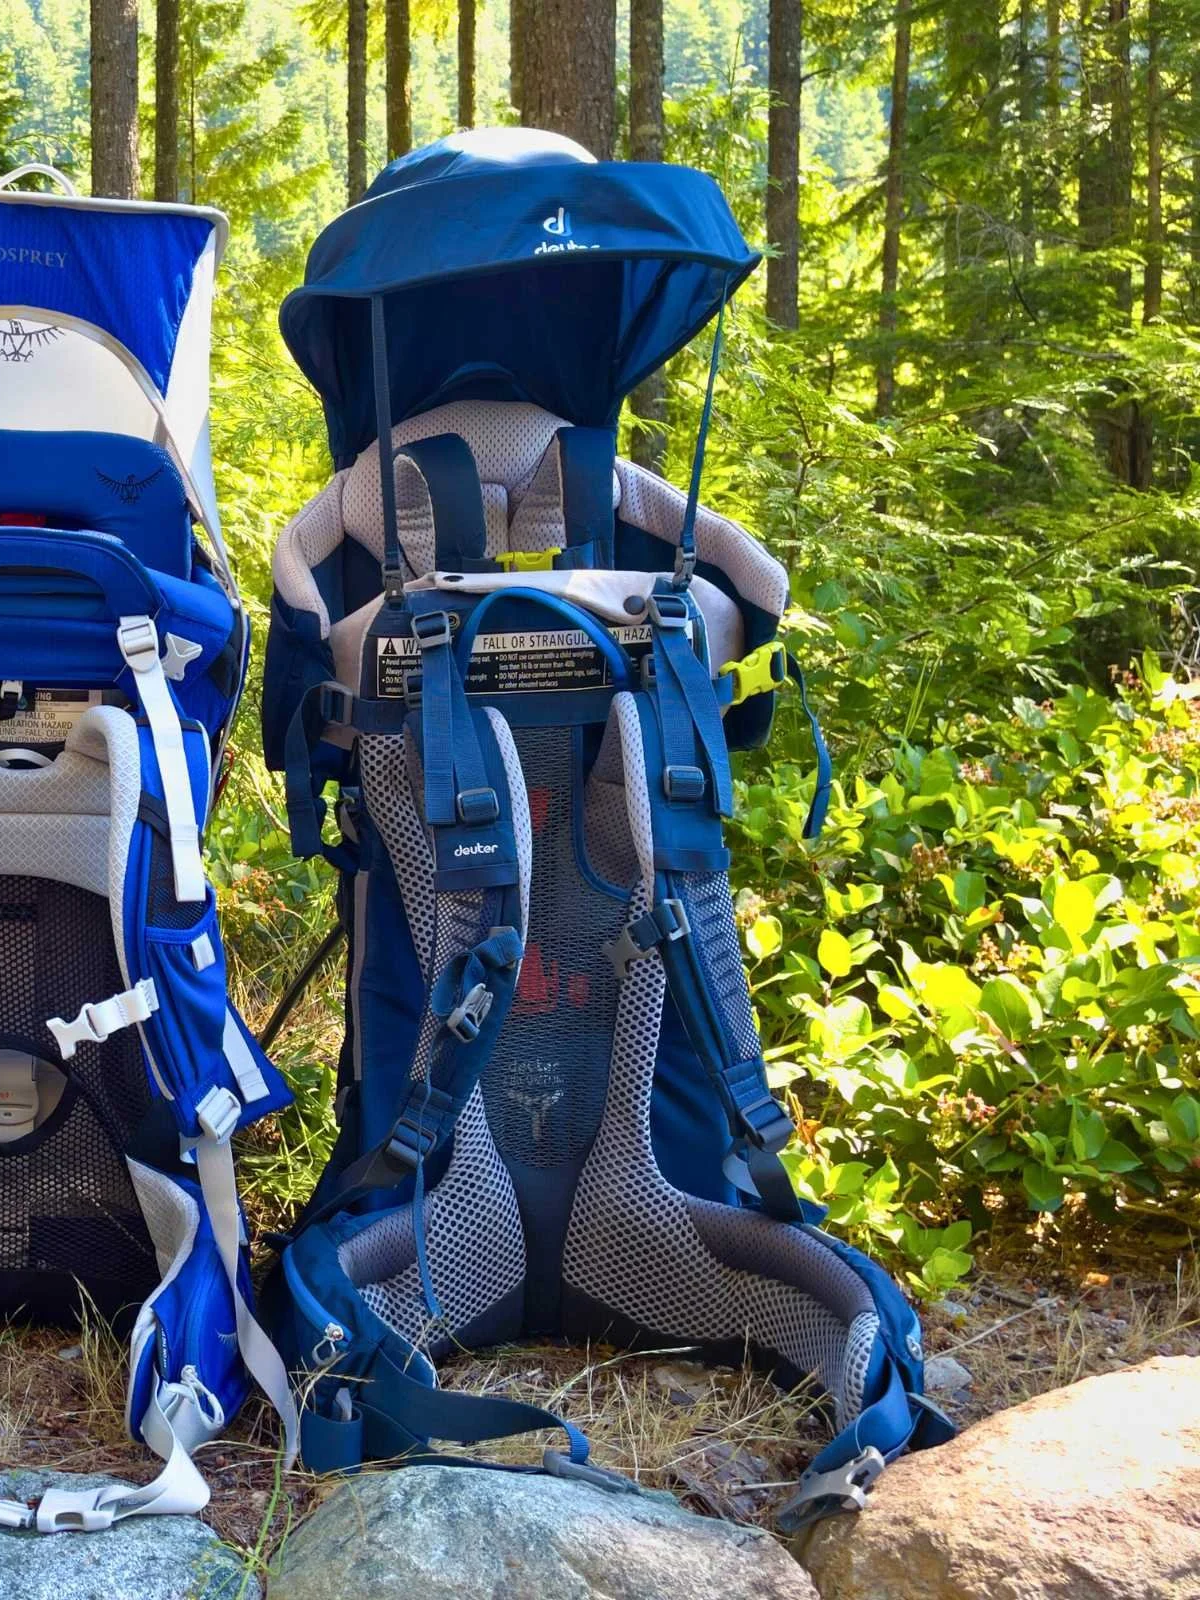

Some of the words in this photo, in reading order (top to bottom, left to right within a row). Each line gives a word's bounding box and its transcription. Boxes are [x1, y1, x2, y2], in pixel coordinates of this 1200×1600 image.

[483, 638, 506, 650] FALL
[512, 636, 525, 647] OR
[530, 630, 620, 647] STRANGULAN
[624, 628, 652, 640] HAZA
[25, 712, 42, 720] FALL
[44, 712, 55, 720] OR
[42, 721, 72, 729] HAZARD
[454, 842, 498, 856] deuter
